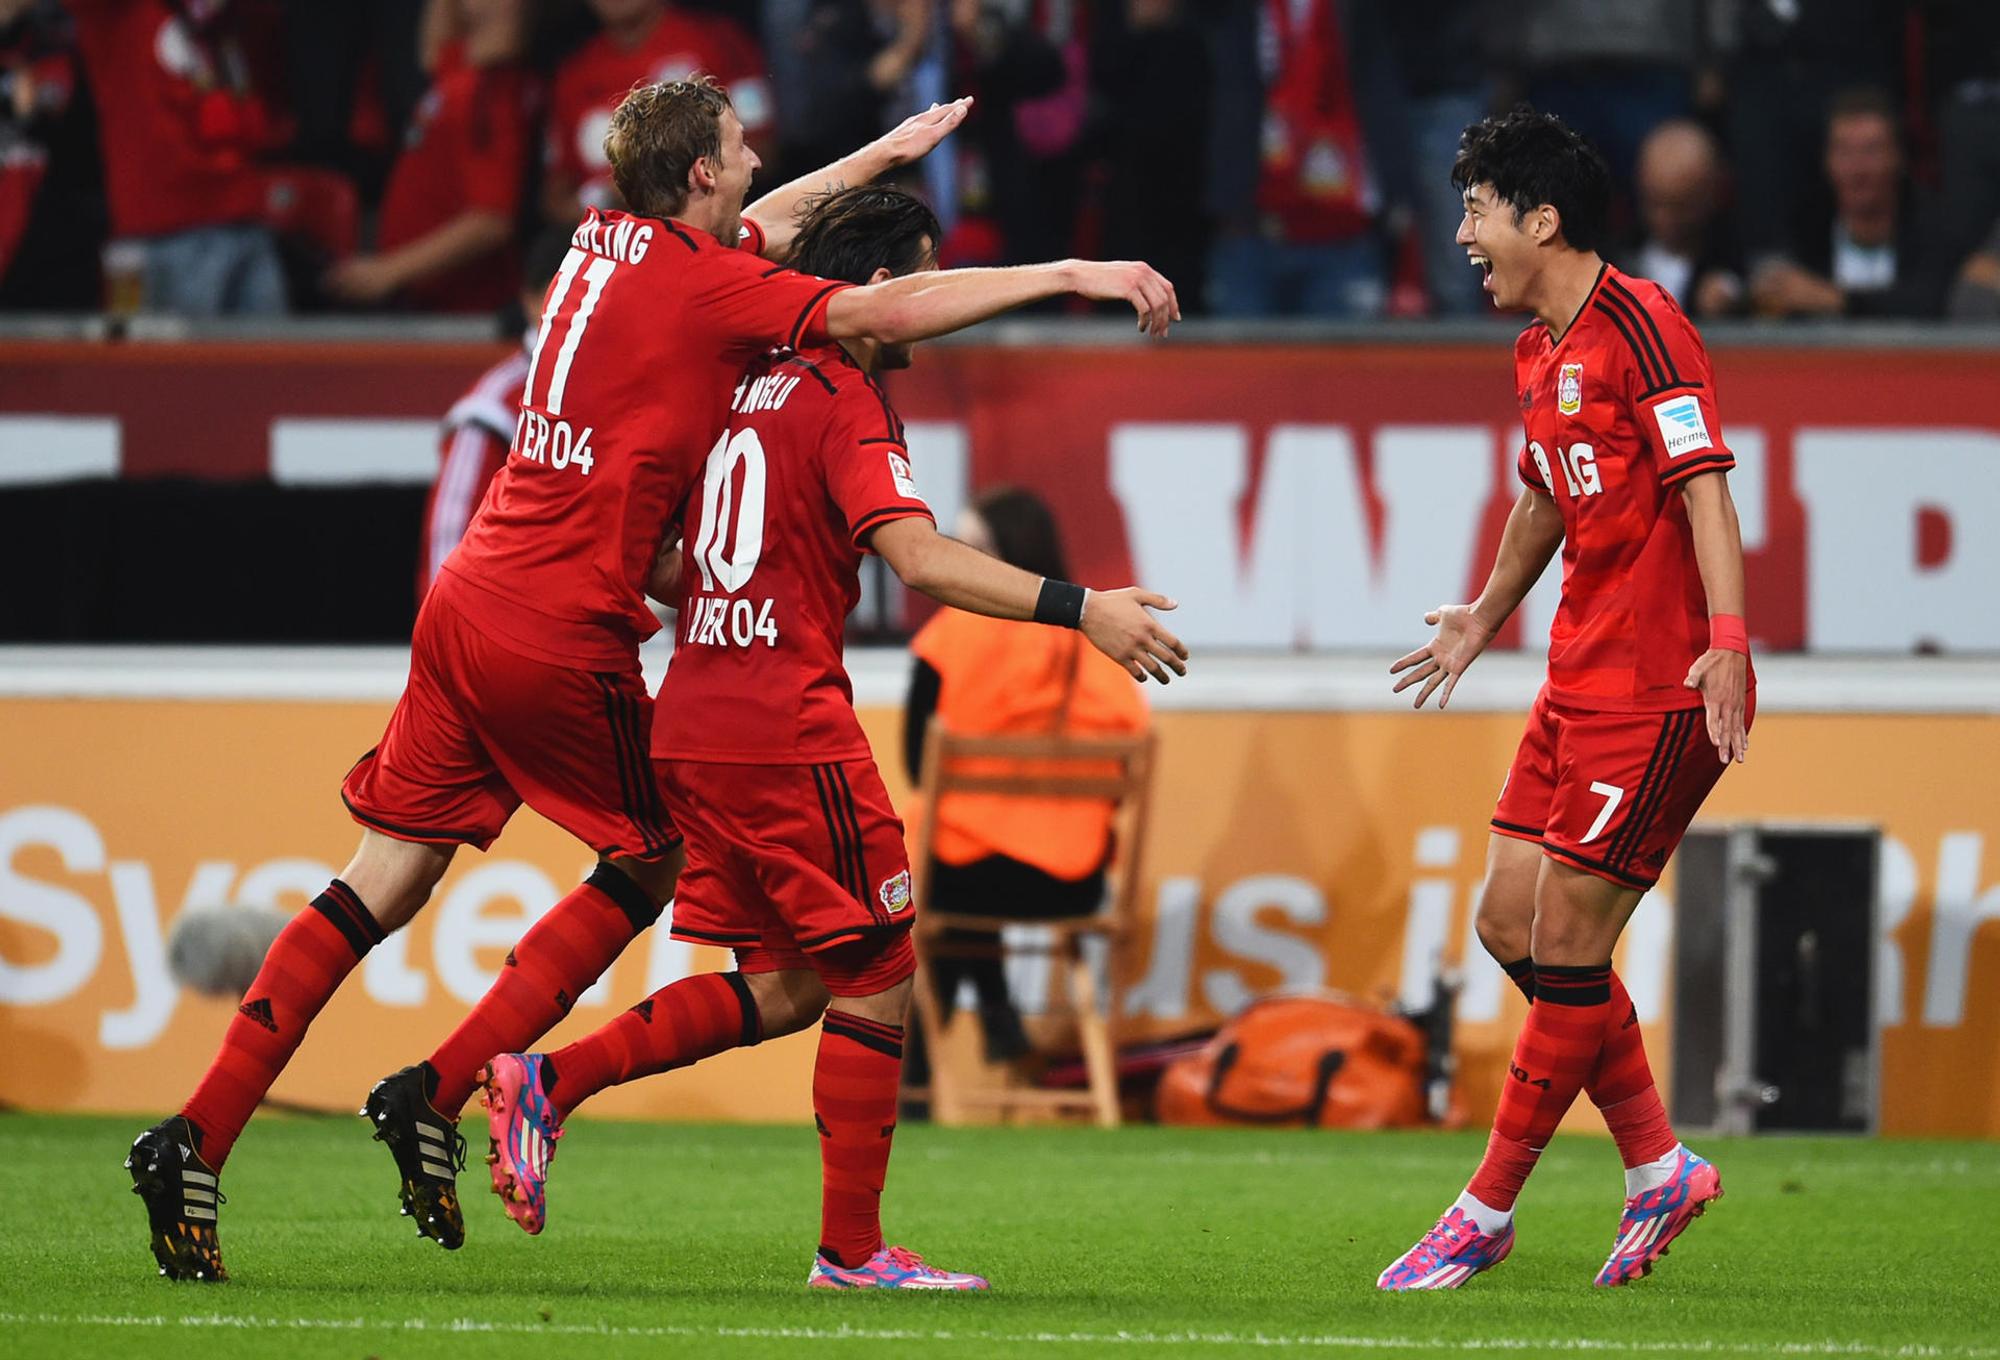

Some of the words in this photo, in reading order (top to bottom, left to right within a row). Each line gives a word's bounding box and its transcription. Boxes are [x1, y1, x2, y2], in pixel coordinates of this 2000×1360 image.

[523, 247, 617, 416] 11
[551, 421, 594, 475] 04
[1668, 431, 1708, 449] Hermes
[1557, 442, 1603, 497] LG
[693, 427, 767, 594] 10
[731, 599, 778, 647] 04
[1579, 780, 1624, 844] 7
